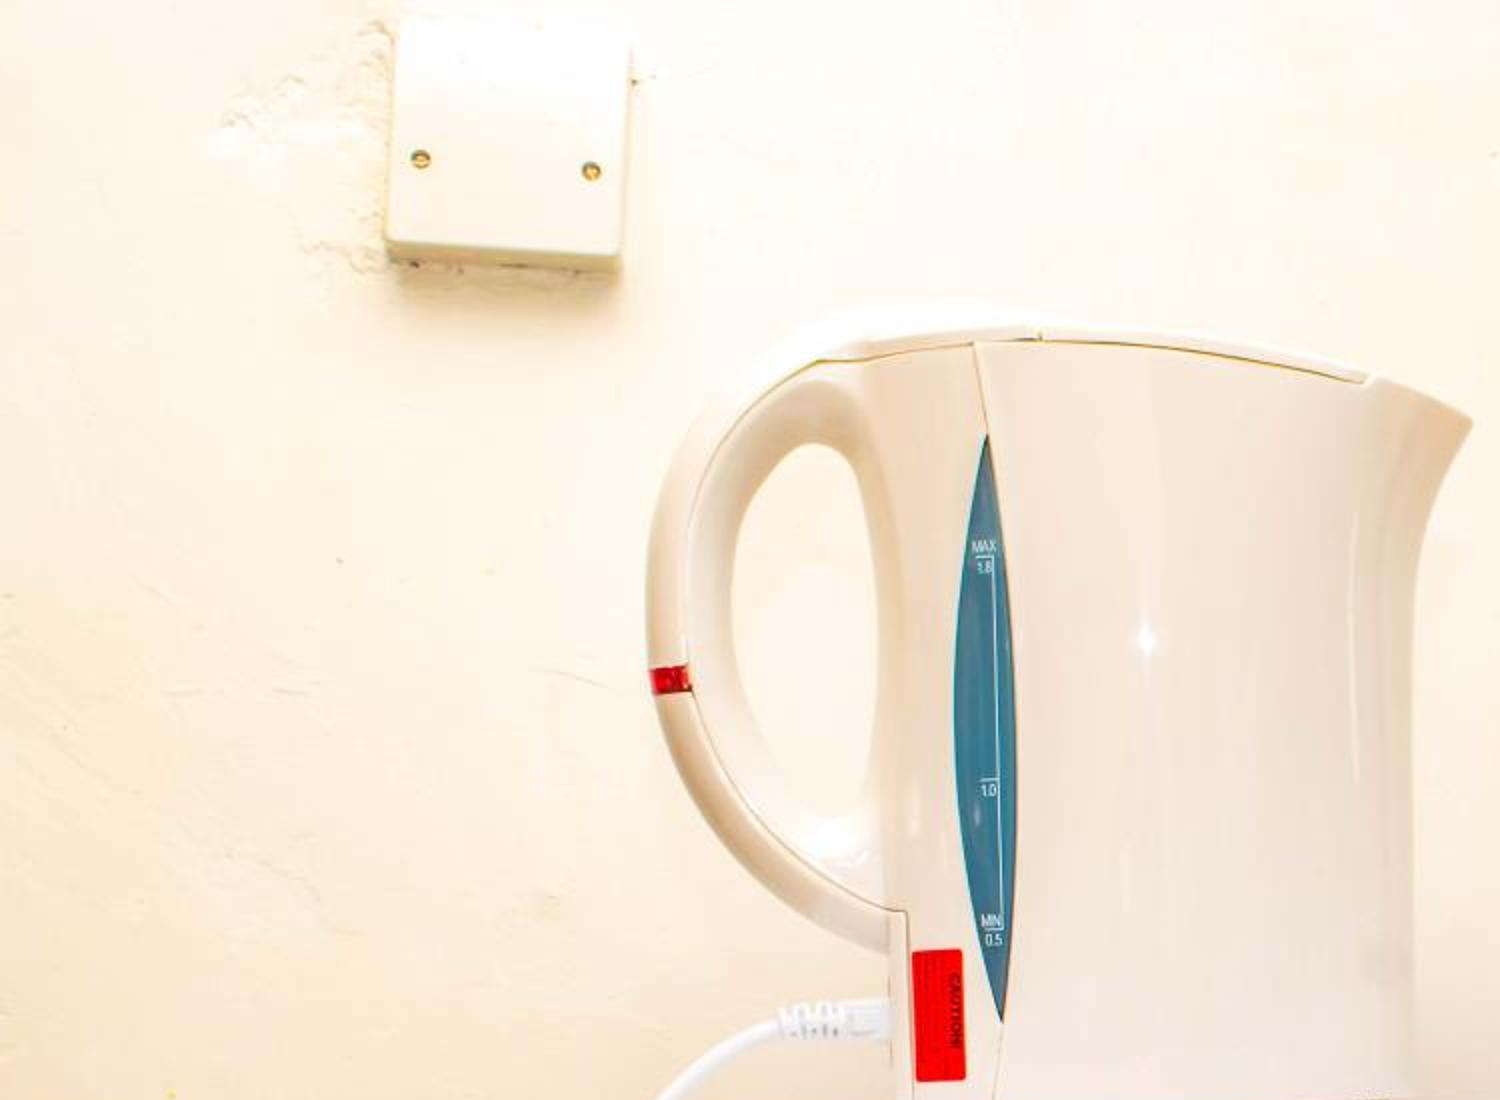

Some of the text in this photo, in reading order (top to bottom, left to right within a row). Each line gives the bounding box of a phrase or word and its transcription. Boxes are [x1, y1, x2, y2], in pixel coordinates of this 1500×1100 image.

[972, 540, 997, 553] MAX
[981, 914, 1001, 928] MIN
[985, 934, 1003, 947] 0.5
